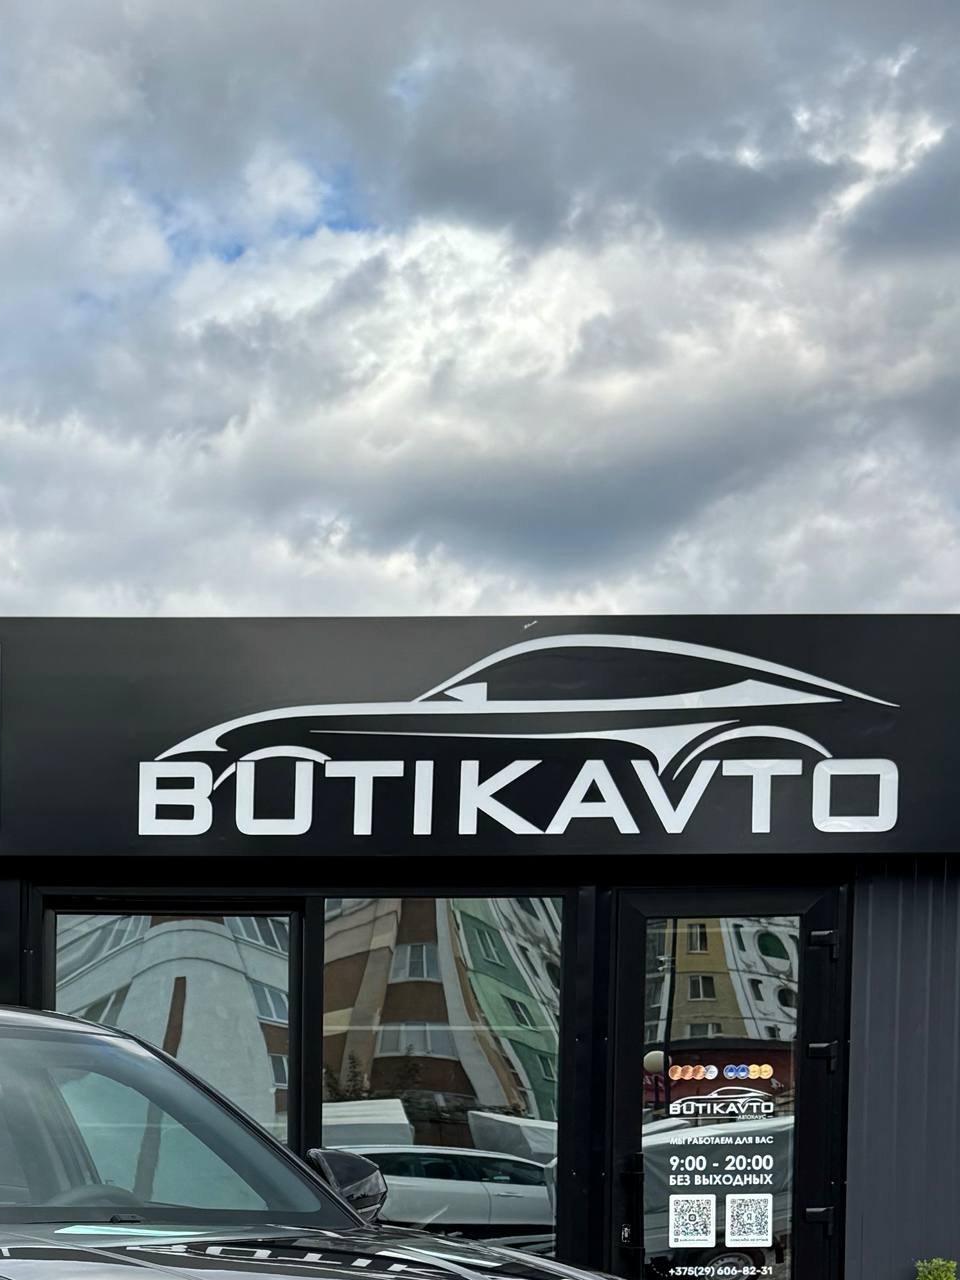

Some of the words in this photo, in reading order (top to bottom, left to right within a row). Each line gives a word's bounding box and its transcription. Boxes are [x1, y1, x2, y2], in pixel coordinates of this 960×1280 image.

[138, 758, 899, 836] BUTIKAVTO
[669, 1101, 774, 1115] BUTIKAVTO
[687, 1136, 734, 1145] РАБОТАЕМ
[735, 1136, 753, 1145] ДЛЯ
[755, 1136, 774, 1144] ВАС
[669, 1156, 707, 1171] 9:00
[724, 1155, 774, 1171] 20:00
[669, 1174, 691, 1186] БЕЗ
[694, 1174, 773, 1187] ВЫХОДНЫХ
[668, 1266, 715, 1277] +375(29)
[717, 1266, 773, 1276] 606-82-31
